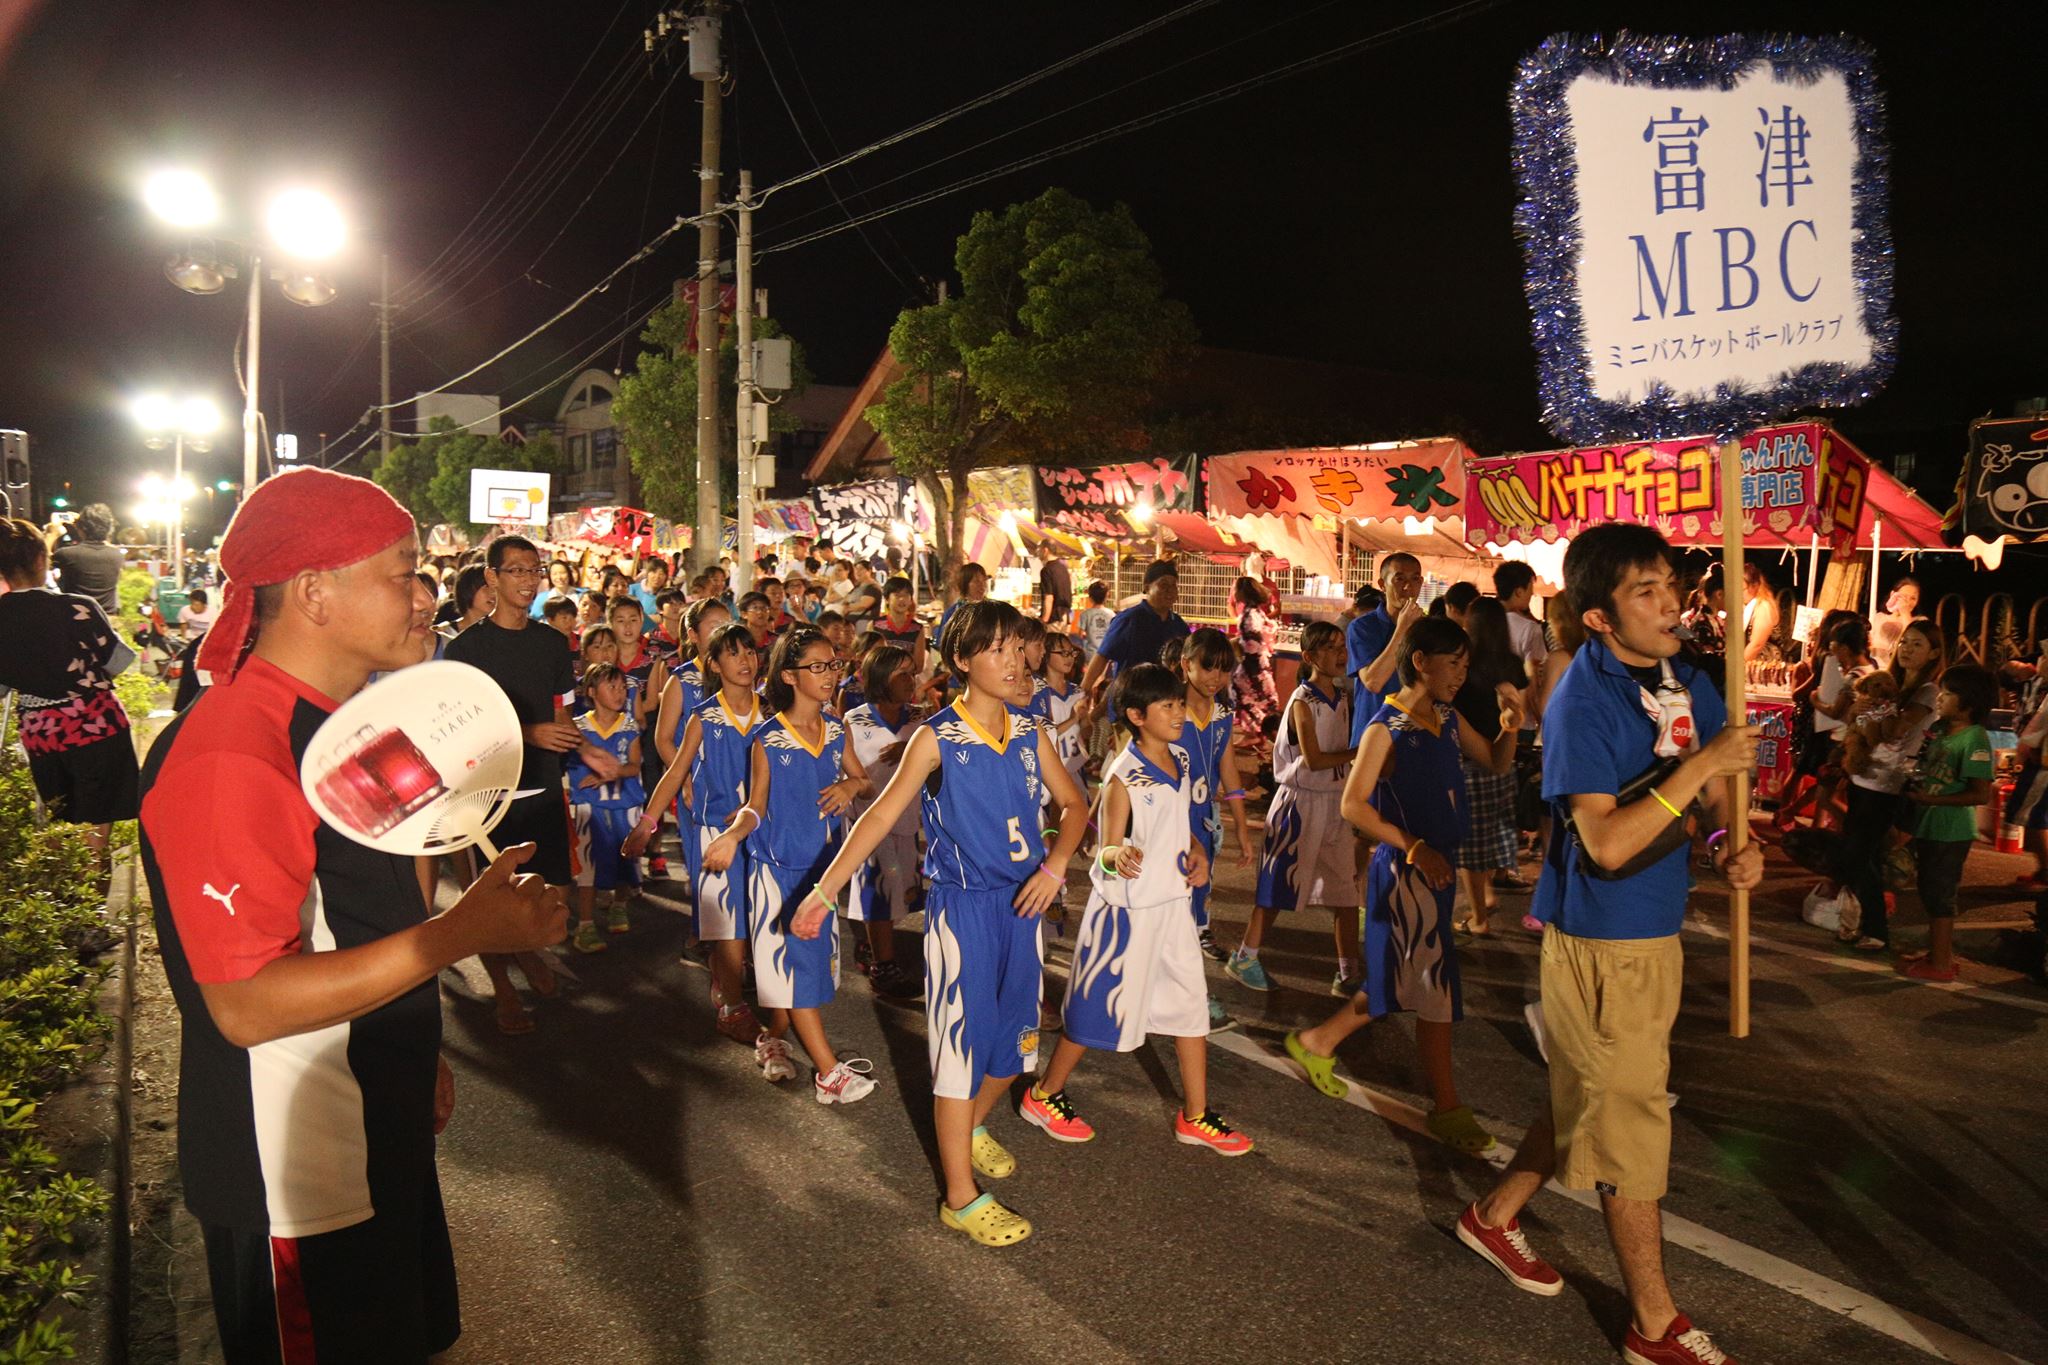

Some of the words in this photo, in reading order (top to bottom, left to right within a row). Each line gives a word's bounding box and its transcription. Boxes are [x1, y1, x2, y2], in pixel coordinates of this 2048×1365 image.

[1643, 104, 1813, 215] 富津
[1628, 219, 1821, 321] MBC
[1273, 456, 1389, 468] シロップかけほうだい
[1741, 433, 1814, 472] ゃんけん
[1236, 465, 1460, 513] かき氷
[1537, 446, 1715, 522] バナナチョコ
[430, 704, 484, 744] STARIA
[1191, 775, 1208, 805] 6
[1006, 815, 1031, 863] 5
